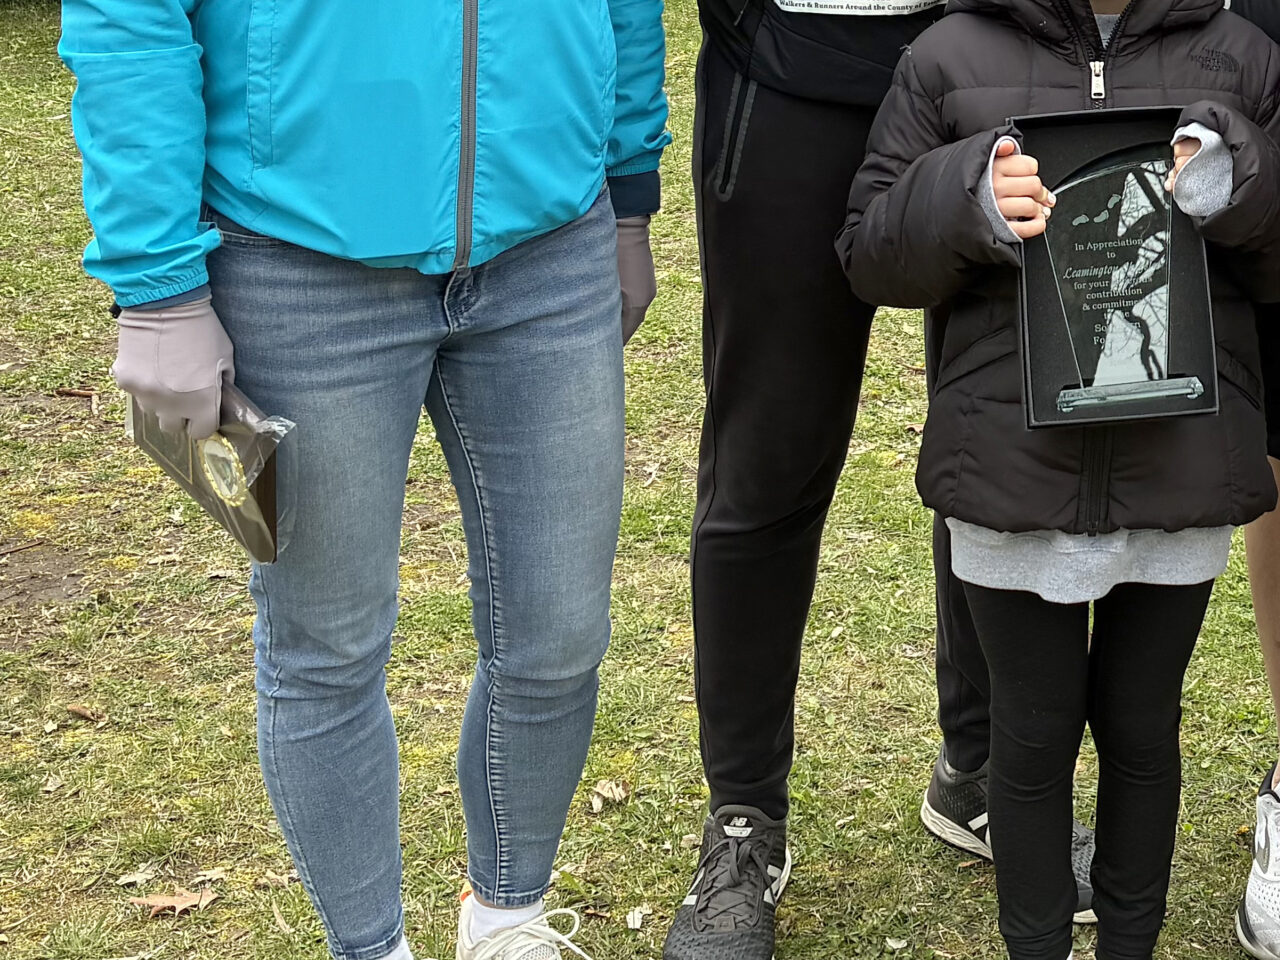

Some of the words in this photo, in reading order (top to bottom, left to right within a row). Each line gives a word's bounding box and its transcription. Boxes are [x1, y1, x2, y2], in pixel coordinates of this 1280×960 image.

[779, 0, 806, 8] Walkers
[814, 2, 844, 10] Runners
[845, 3, 873, 11] Around
[873, 3, 886, 11] the
[887, 3, 914, 12] County
[1075, 242, 1084, 251] In
[1086, 237, 1143, 251] Appreciation
[1106, 250, 1116, 259] to
[1073, 281, 1087, 290] for
[1088, 280, 1110, 291] your
[1082, 303, 1091, 311] &
[1092, 299, 1140, 310] commitme
